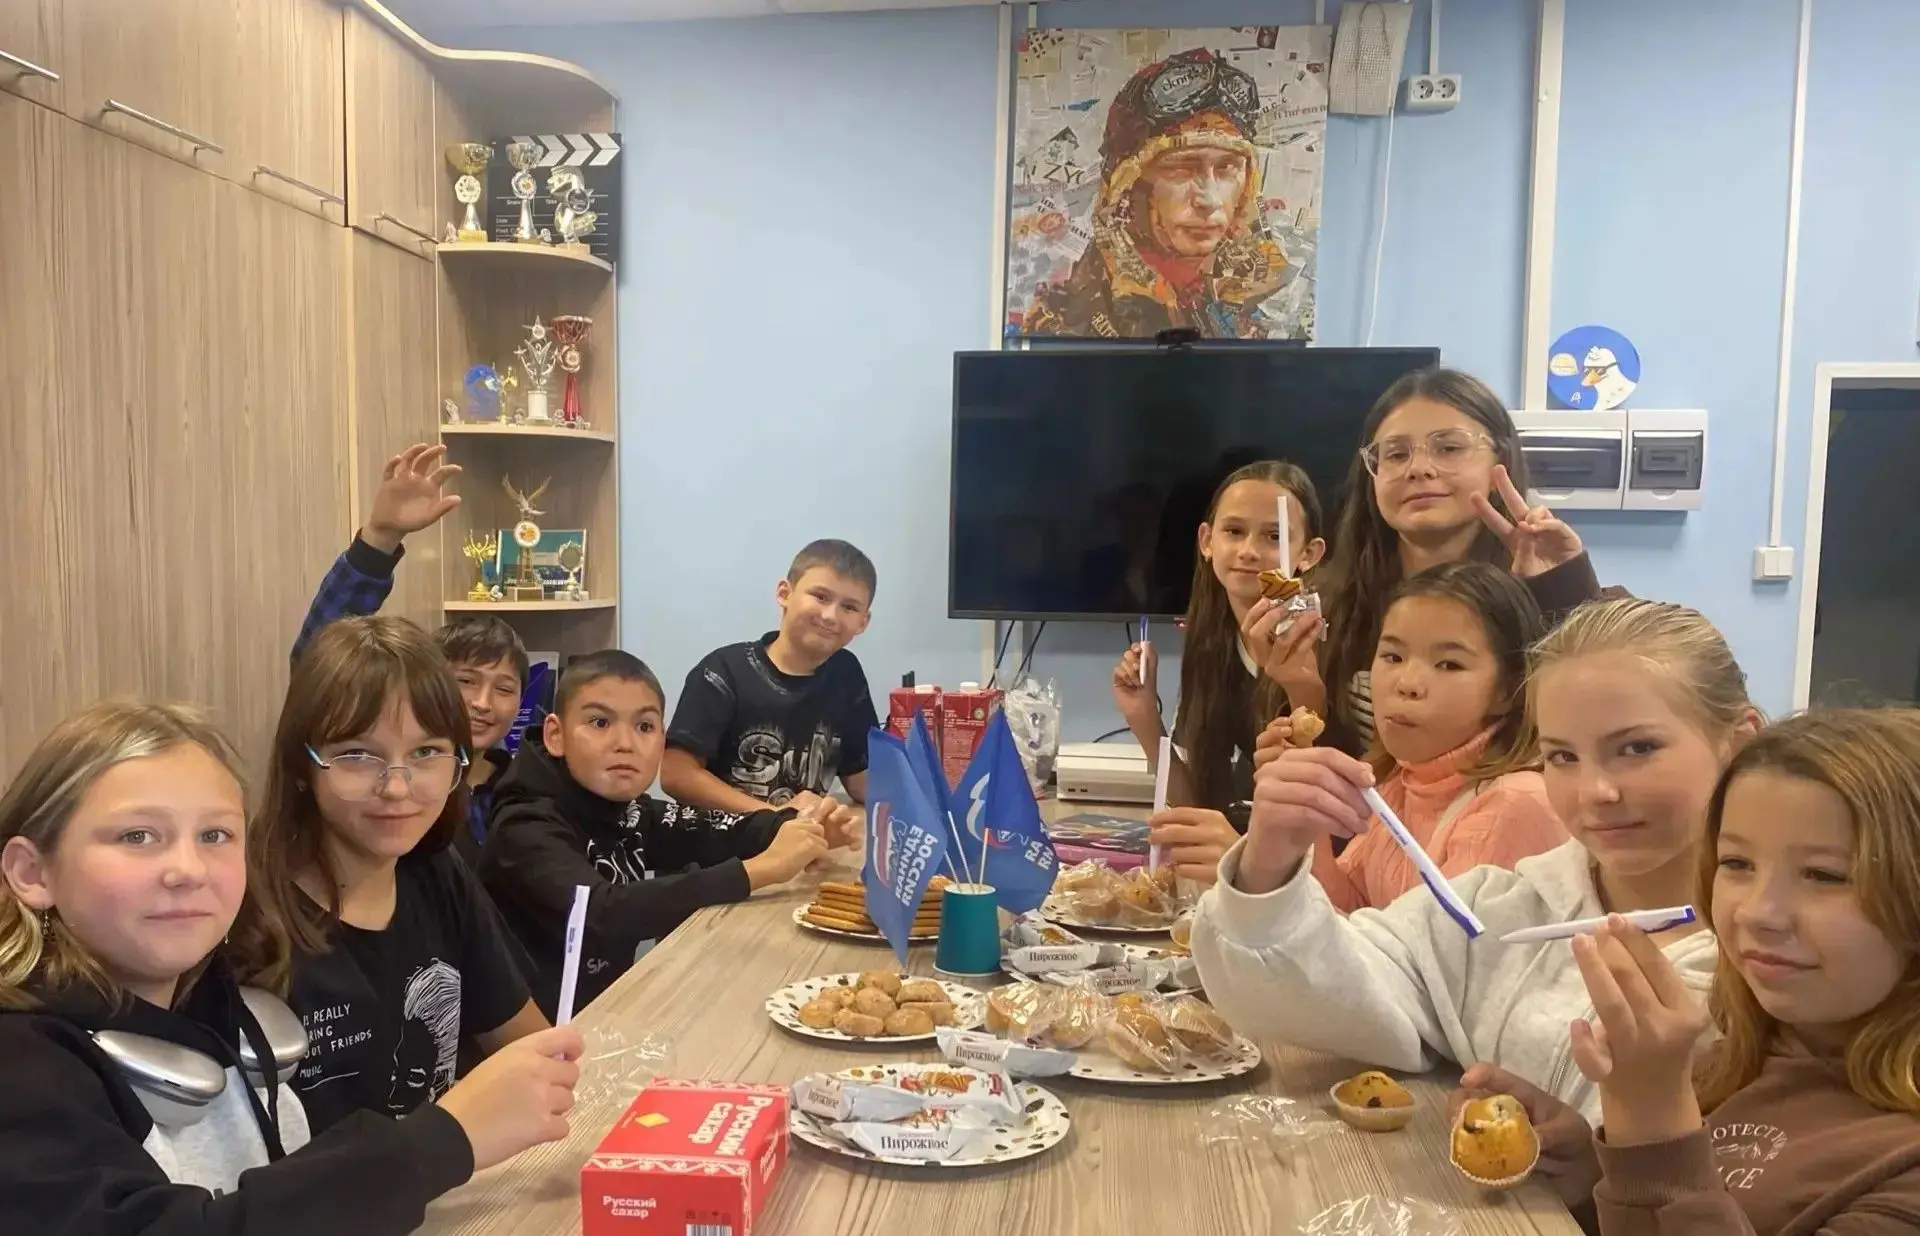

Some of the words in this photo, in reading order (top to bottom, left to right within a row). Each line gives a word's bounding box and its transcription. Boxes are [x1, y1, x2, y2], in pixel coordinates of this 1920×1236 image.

[313, 1003, 351, 1025] REALLY
[308, 1025, 334, 1043] RING
[330, 1028, 372, 1053] FRIENDS
[688, 1101, 734, 1145] сахар
[713, 1095, 774, 1157] Русский
[880, 1134, 949, 1153] Пирожное
[602, 1195, 657, 1209] Русский
[611, 1206, 649, 1219] сахар
